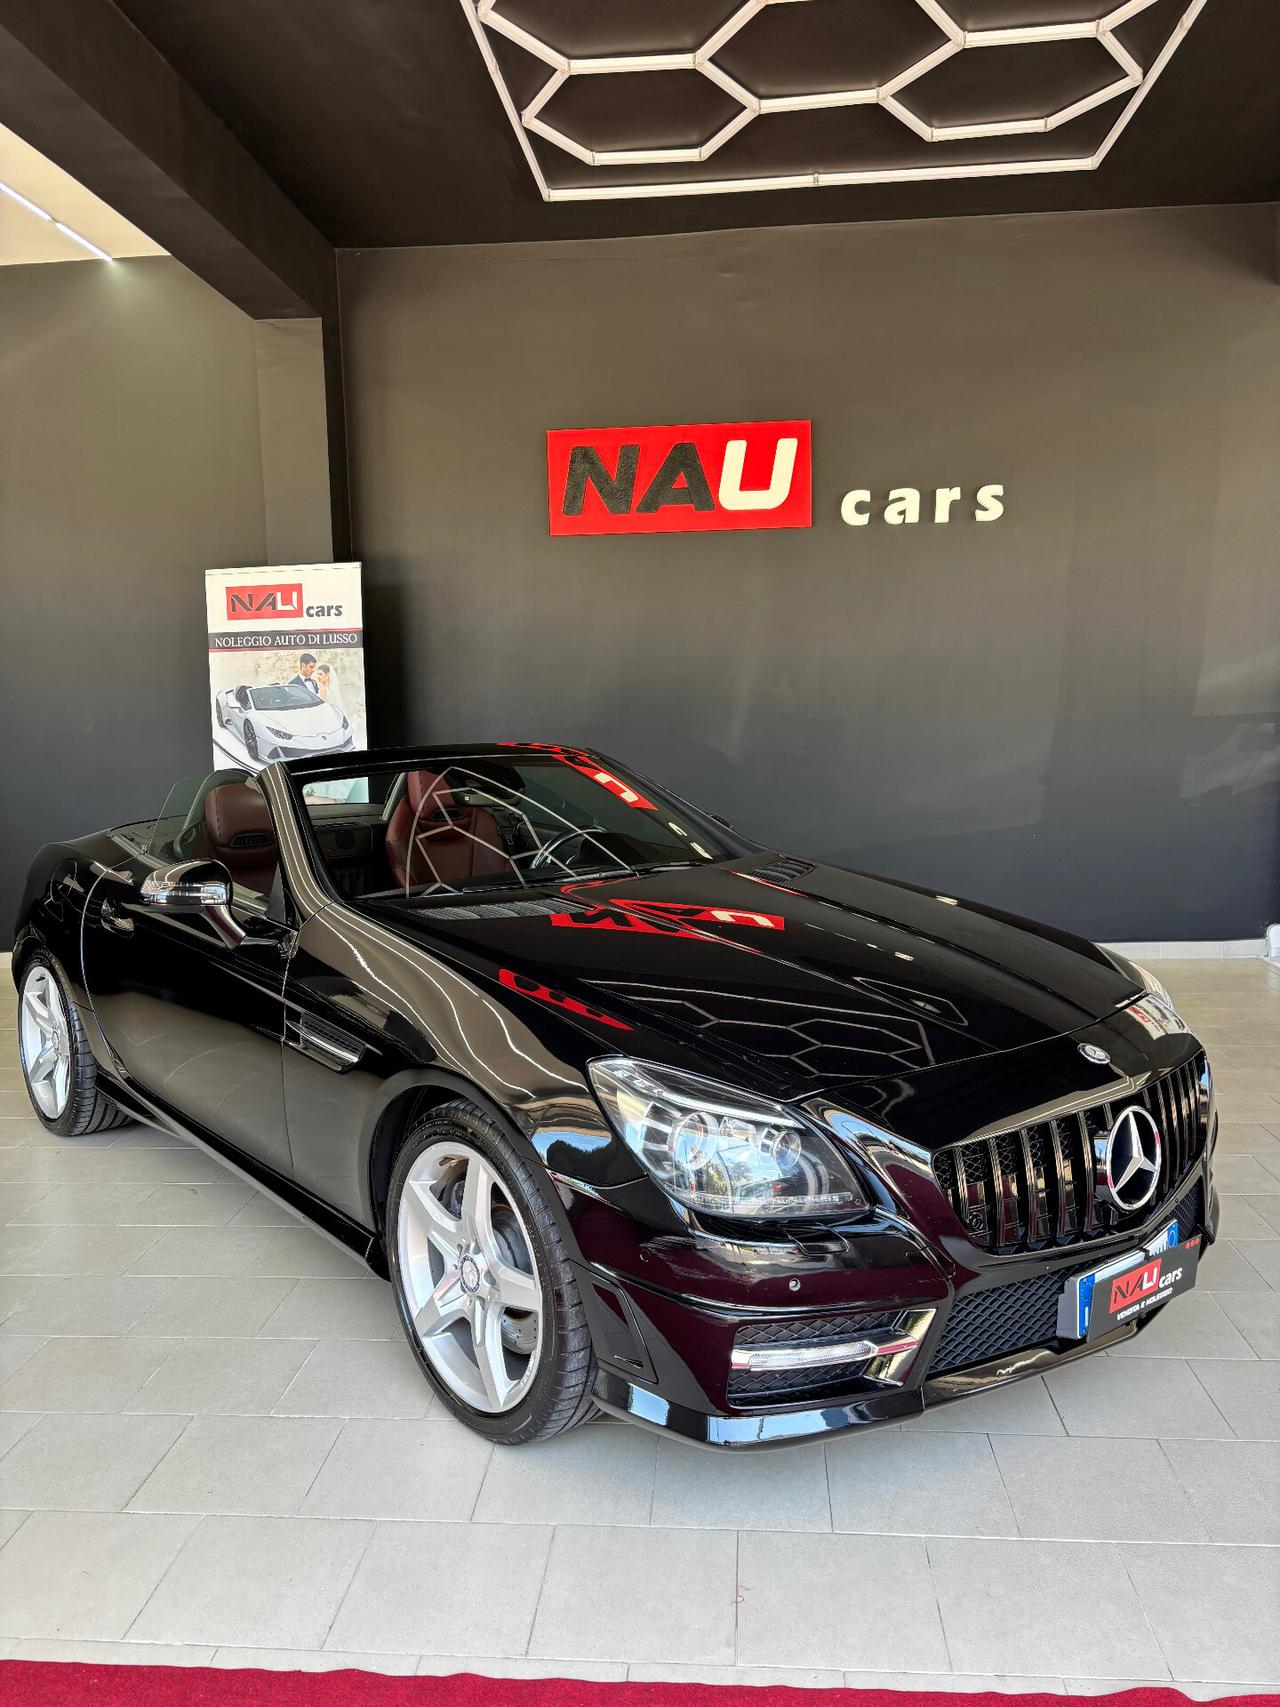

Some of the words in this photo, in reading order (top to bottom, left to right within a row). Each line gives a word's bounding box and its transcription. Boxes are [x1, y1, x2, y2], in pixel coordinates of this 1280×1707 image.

[562, 438, 798, 516] NAU
[840, 484, 1004, 526] cars
[231, 591, 298, 612] NAU
[305, 604, 343, 617] cars
[215, 636, 272, 647] NOLEGGIO
[274, 634, 306, 646] AUTO
[308, 634, 320, 645] DI
[323, 633, 358, 644] LUSSO
[1113, 1267, 1158, 1304] NAU
[1159, 1267, 1183, 1288] cars
